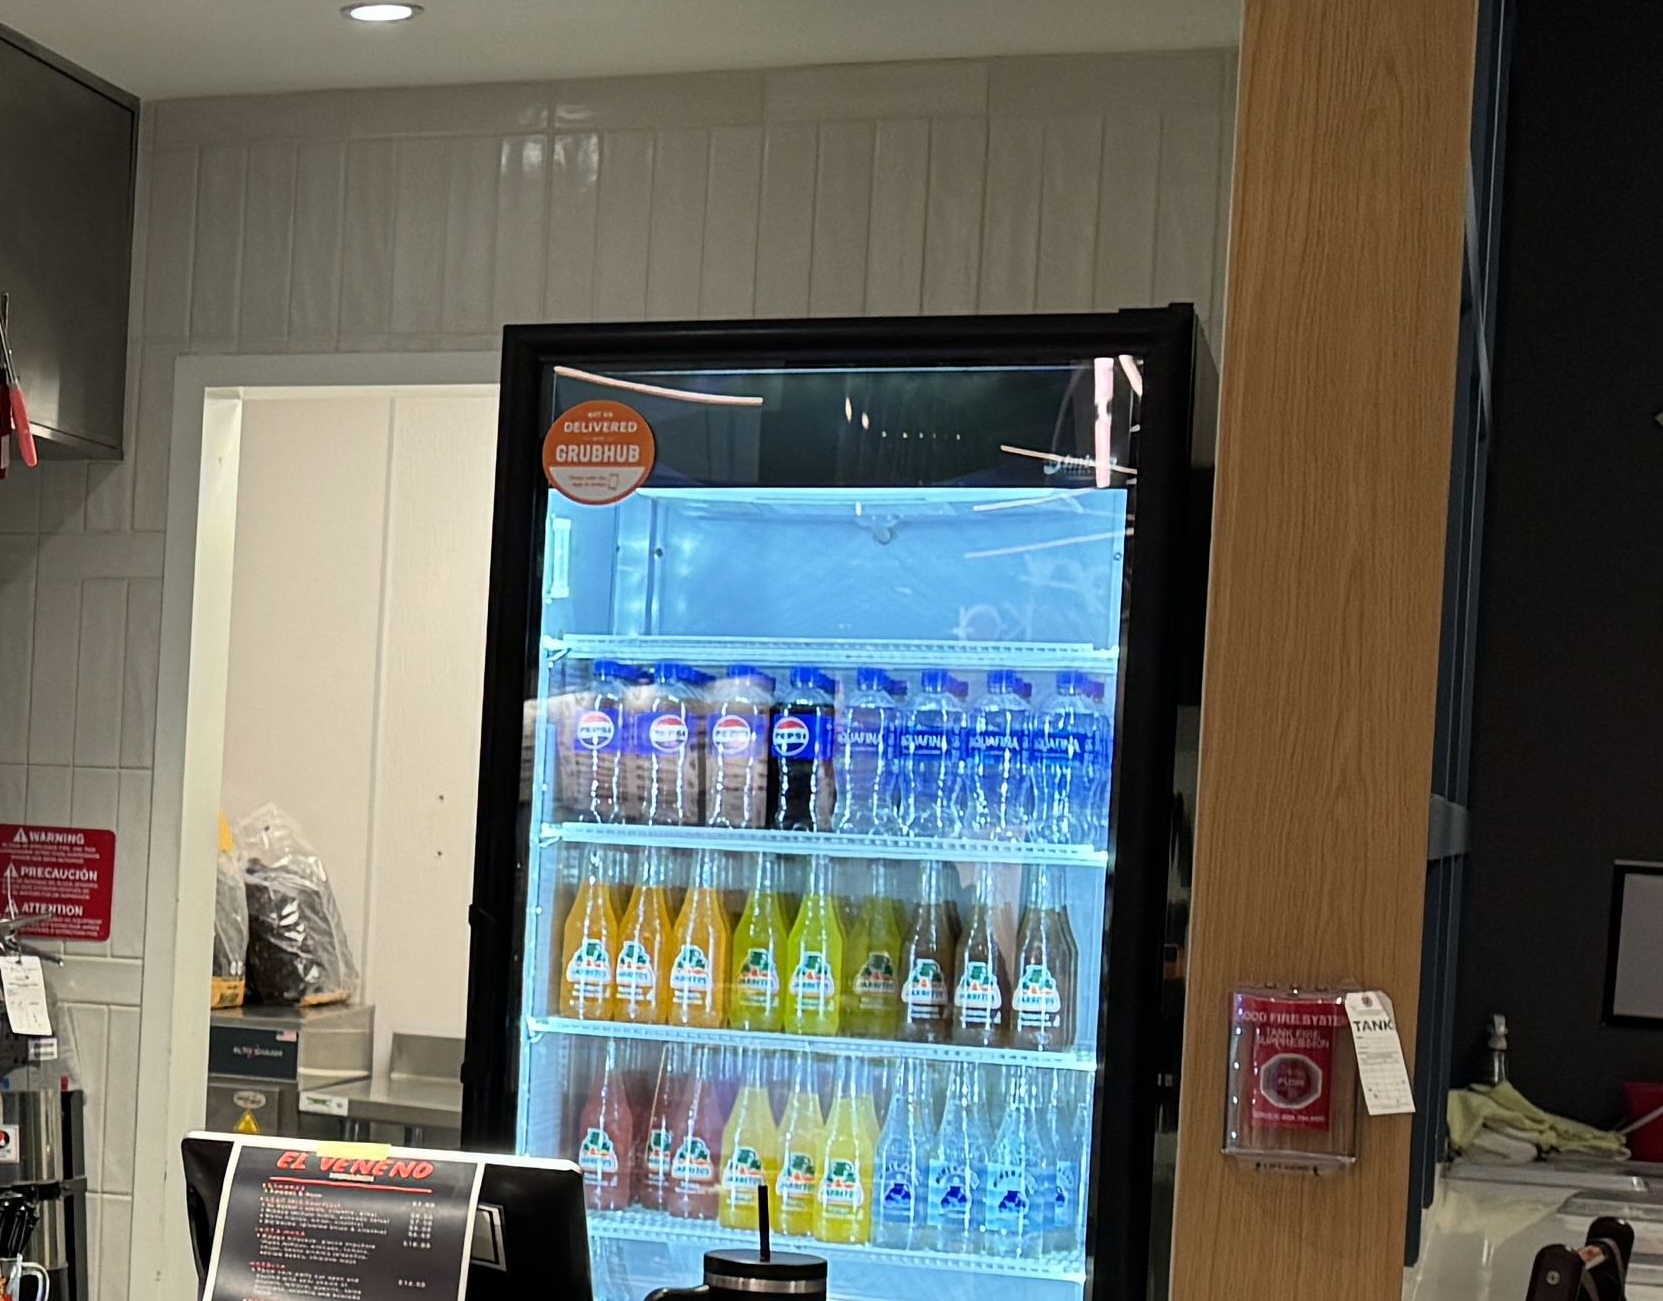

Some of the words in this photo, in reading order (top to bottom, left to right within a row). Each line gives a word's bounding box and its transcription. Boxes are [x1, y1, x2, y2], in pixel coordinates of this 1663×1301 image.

[564, 421, 638, 433] DELIVERED
[555, 444, 640, 463] GRUBHUB
[775, 732, 807, 740] PEPSI
[29, 831, 85, 845] WARNING
[20, 866, 98, 881] PRECAUCIÓN
[21, 902, 84, 917] ATTENTION
[1353, 1019, 1394, 1032] TANK
[276, 1150, 310, 1171] EL
[320, 1156, 434, 1181] VENENO
